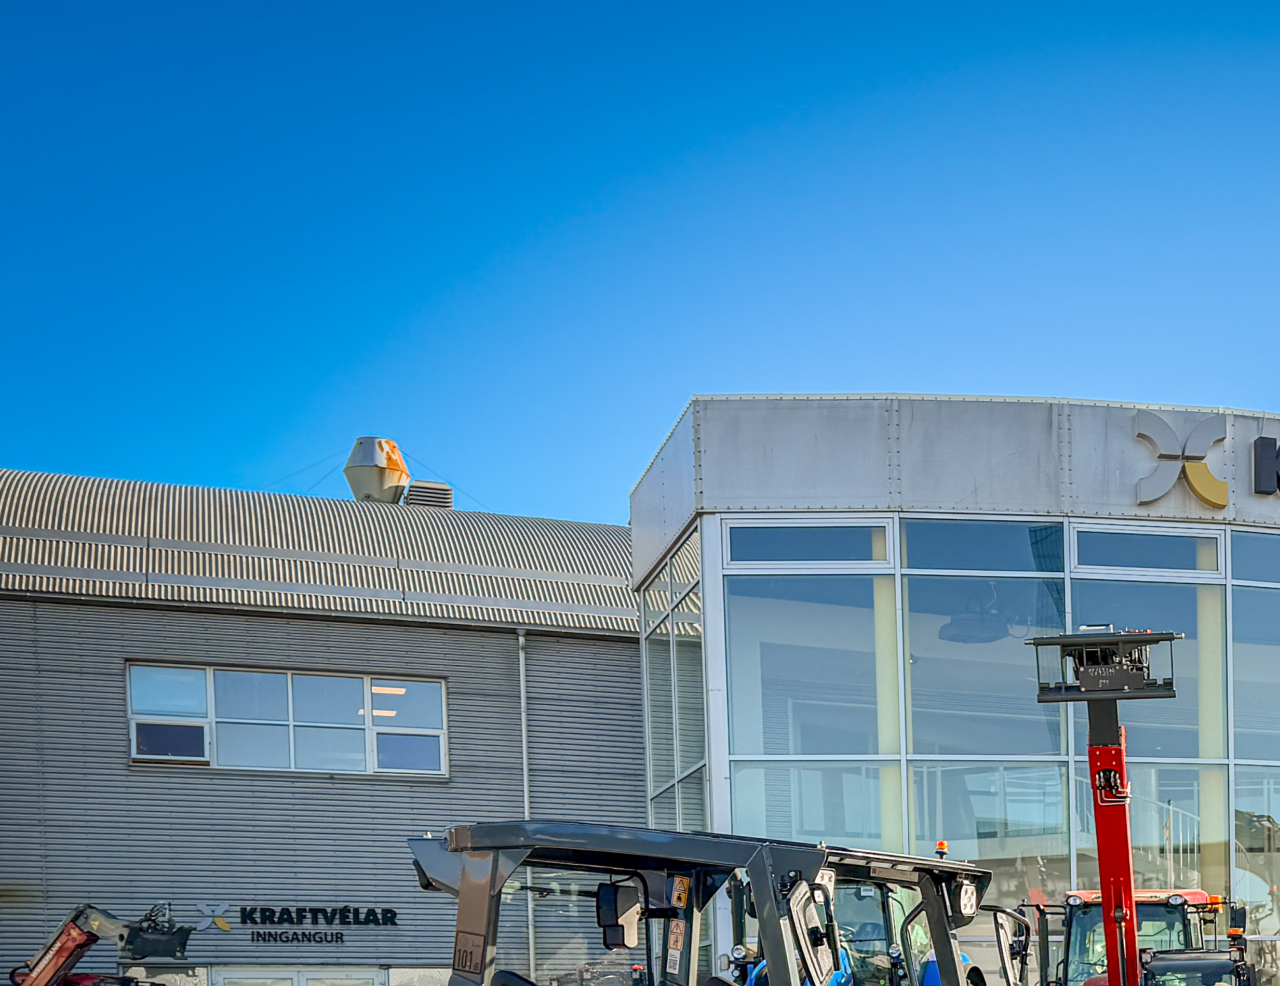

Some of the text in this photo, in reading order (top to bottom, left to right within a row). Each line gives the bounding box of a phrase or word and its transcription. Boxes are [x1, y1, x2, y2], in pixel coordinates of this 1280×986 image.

[240, 905, 398, 926] KRAFTVÉLAR
[251, 931, 344, 943] INNGANGUR
[457, 949, 473, 970] 101
